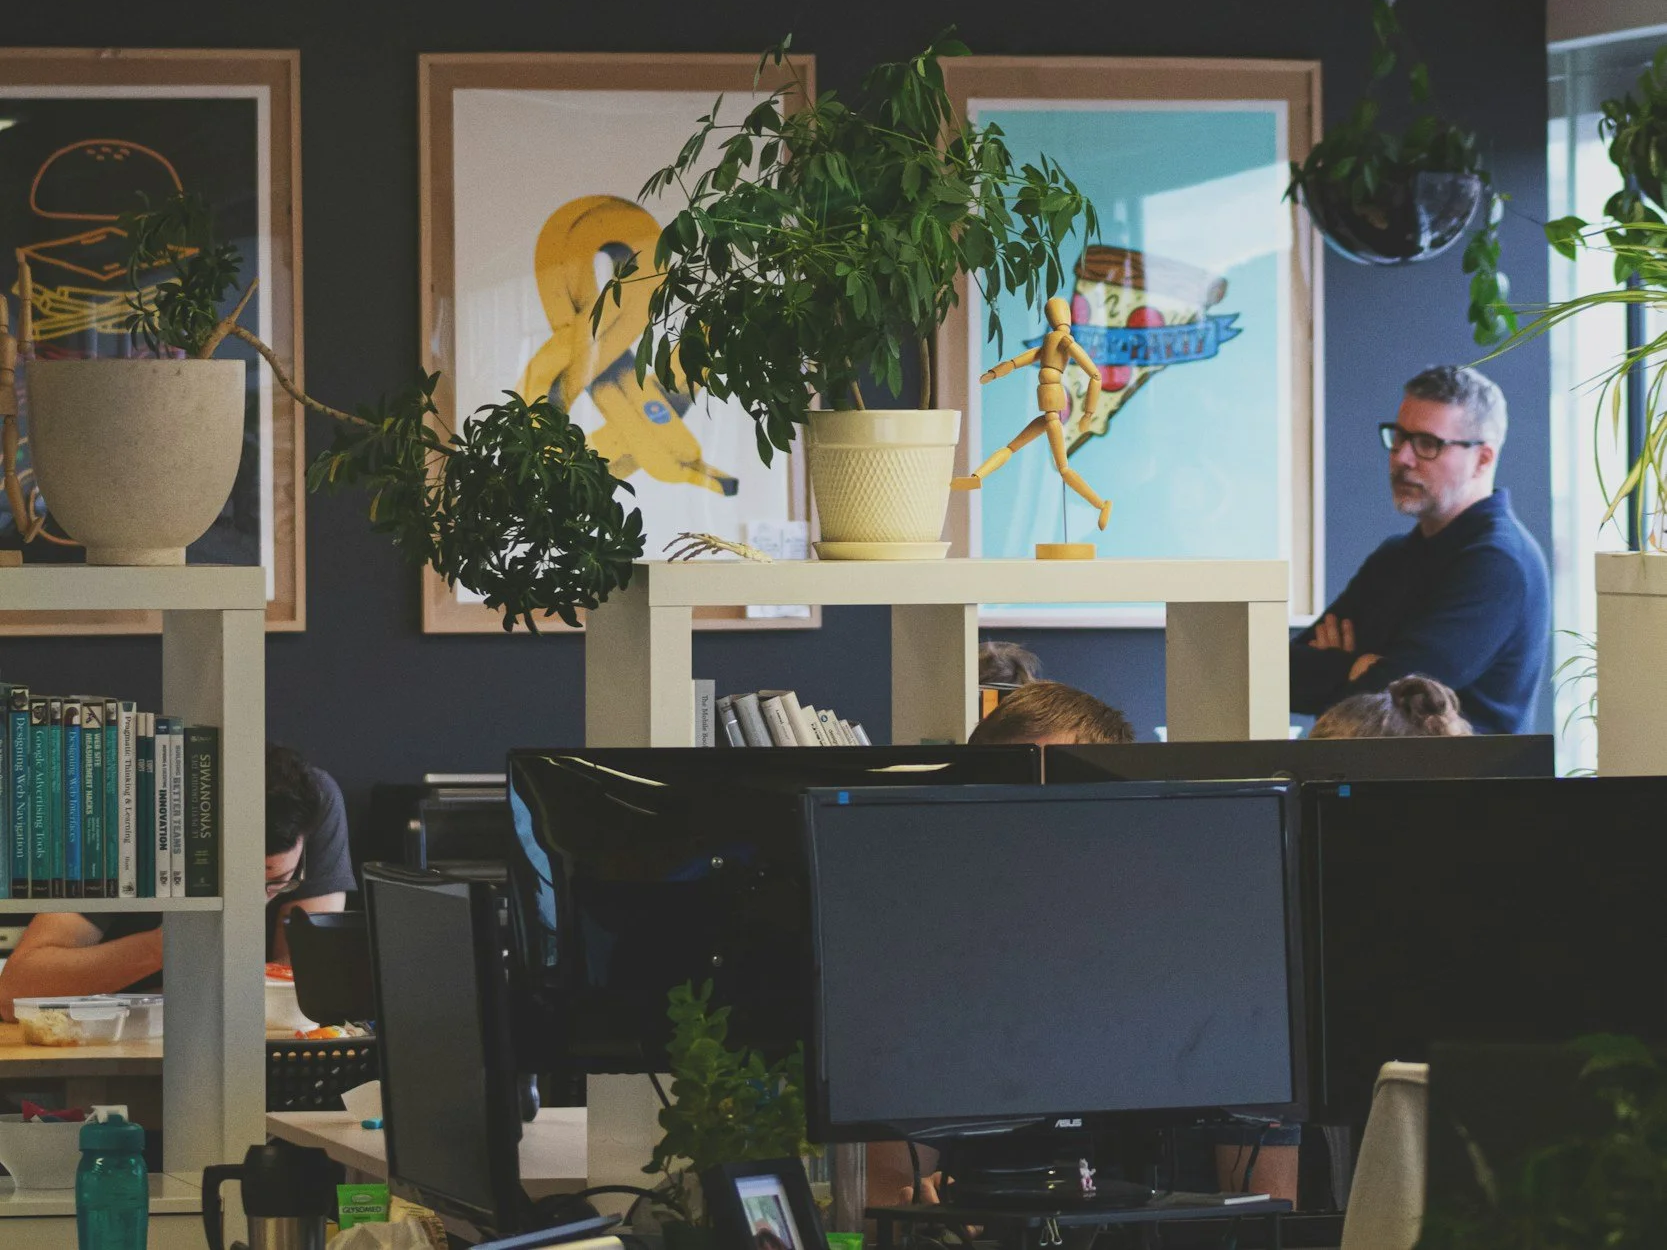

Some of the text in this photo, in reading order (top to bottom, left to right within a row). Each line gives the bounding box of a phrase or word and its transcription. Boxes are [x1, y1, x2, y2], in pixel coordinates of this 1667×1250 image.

[701, 694, 709, 707] The
[701, 708, 709, 732] Mobile
[122, 716, 132, 757] Pragmatic
[85, 733, 93, 789] MEASUREMENT
[122, 759, 132, 796] Thinking
[14, 716, 26, 858] Designing Web Navigation
[34, 730, 45, 859] Google Advertising Tools
[68, 730, 77, 843] Designing Web Interfaces
[85, 790, 93, 815] HACKS
[172, 777, 181, 816] BETTER
[200, 754, 211, 839] SYNONYMES
[122, 807, 132, 844] Learning
[158, 789, 167, 851] INNOVATION
[172, 819, 181, 855] TEAMS
[1054, 1118, 1082, 1128] ASUS
